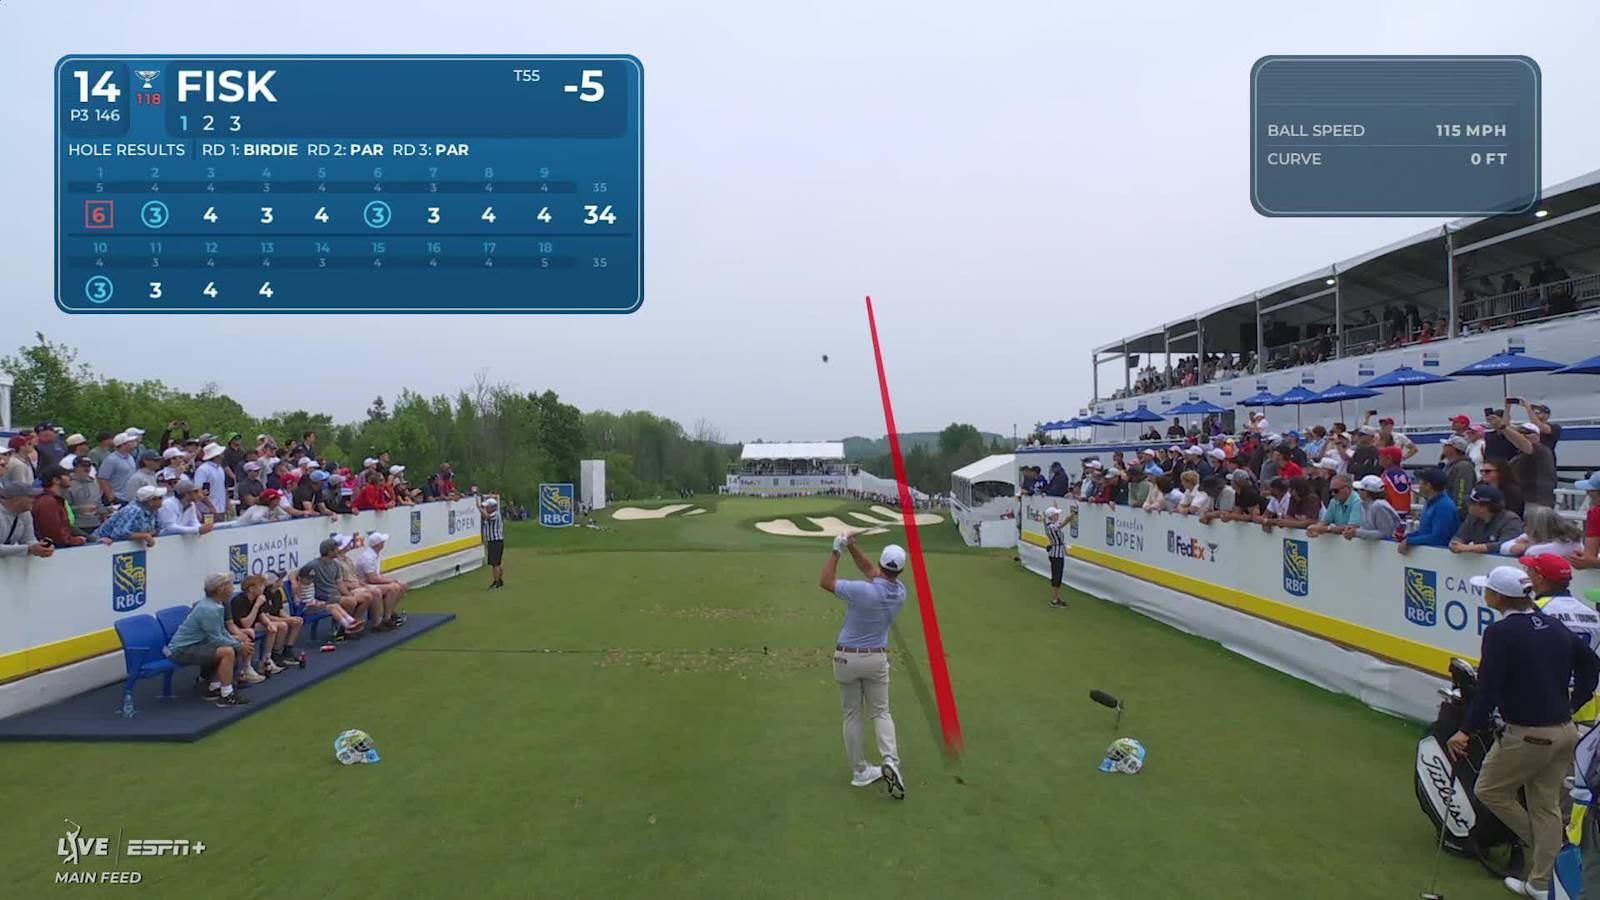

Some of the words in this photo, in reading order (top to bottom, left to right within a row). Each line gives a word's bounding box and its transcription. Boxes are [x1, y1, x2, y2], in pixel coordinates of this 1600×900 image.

[543, 513, 570, 524] RBC
[1115, 532, 1144, 553] OPEN
[1176, 535, 1206, 561] FedEx
[252, 551, 299, 577] OPEN
[1285, 577, 1307, 594] RBC
[116, 591, 145, 610] RBC
[1407, 606, 1435, 625] RBC
[1444, 600, 1495, 636] OP
[1420, 754, 1470, 830] Titleist
